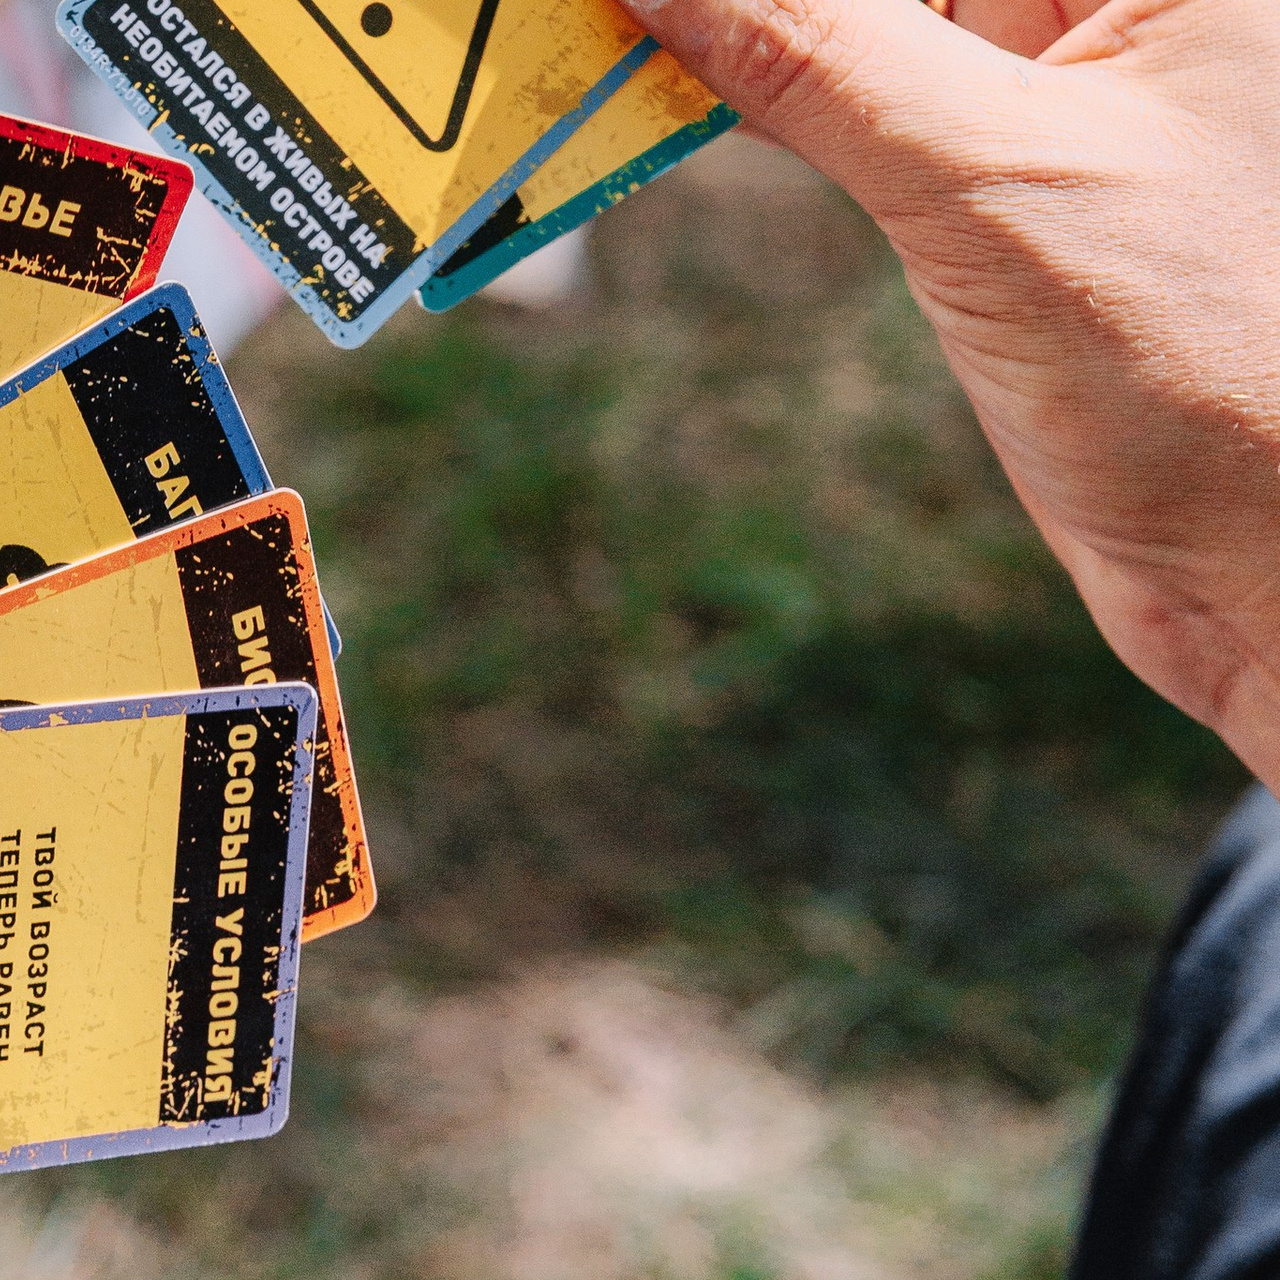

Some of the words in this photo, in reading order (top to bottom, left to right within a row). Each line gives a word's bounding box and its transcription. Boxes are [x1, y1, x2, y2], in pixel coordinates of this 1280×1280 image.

[110, 3, 276, 191] НЕОБИТАЕМОМ
[270, 187, 376, 303] ОСТРОВЕ
[244, 102, 271, 132] В
[263, 126, 358, 231] ЖИВЫХ
[349, 224, 388, 270] НА
[30, 826, 58, 910] ТВОЙ
[216, 723, 258, 898] ОСОБЫЕ
[23, 921, 51, 1058] ВОЗРАСТ
[203, 907, 245, 1103] УСЛОВИЯ
